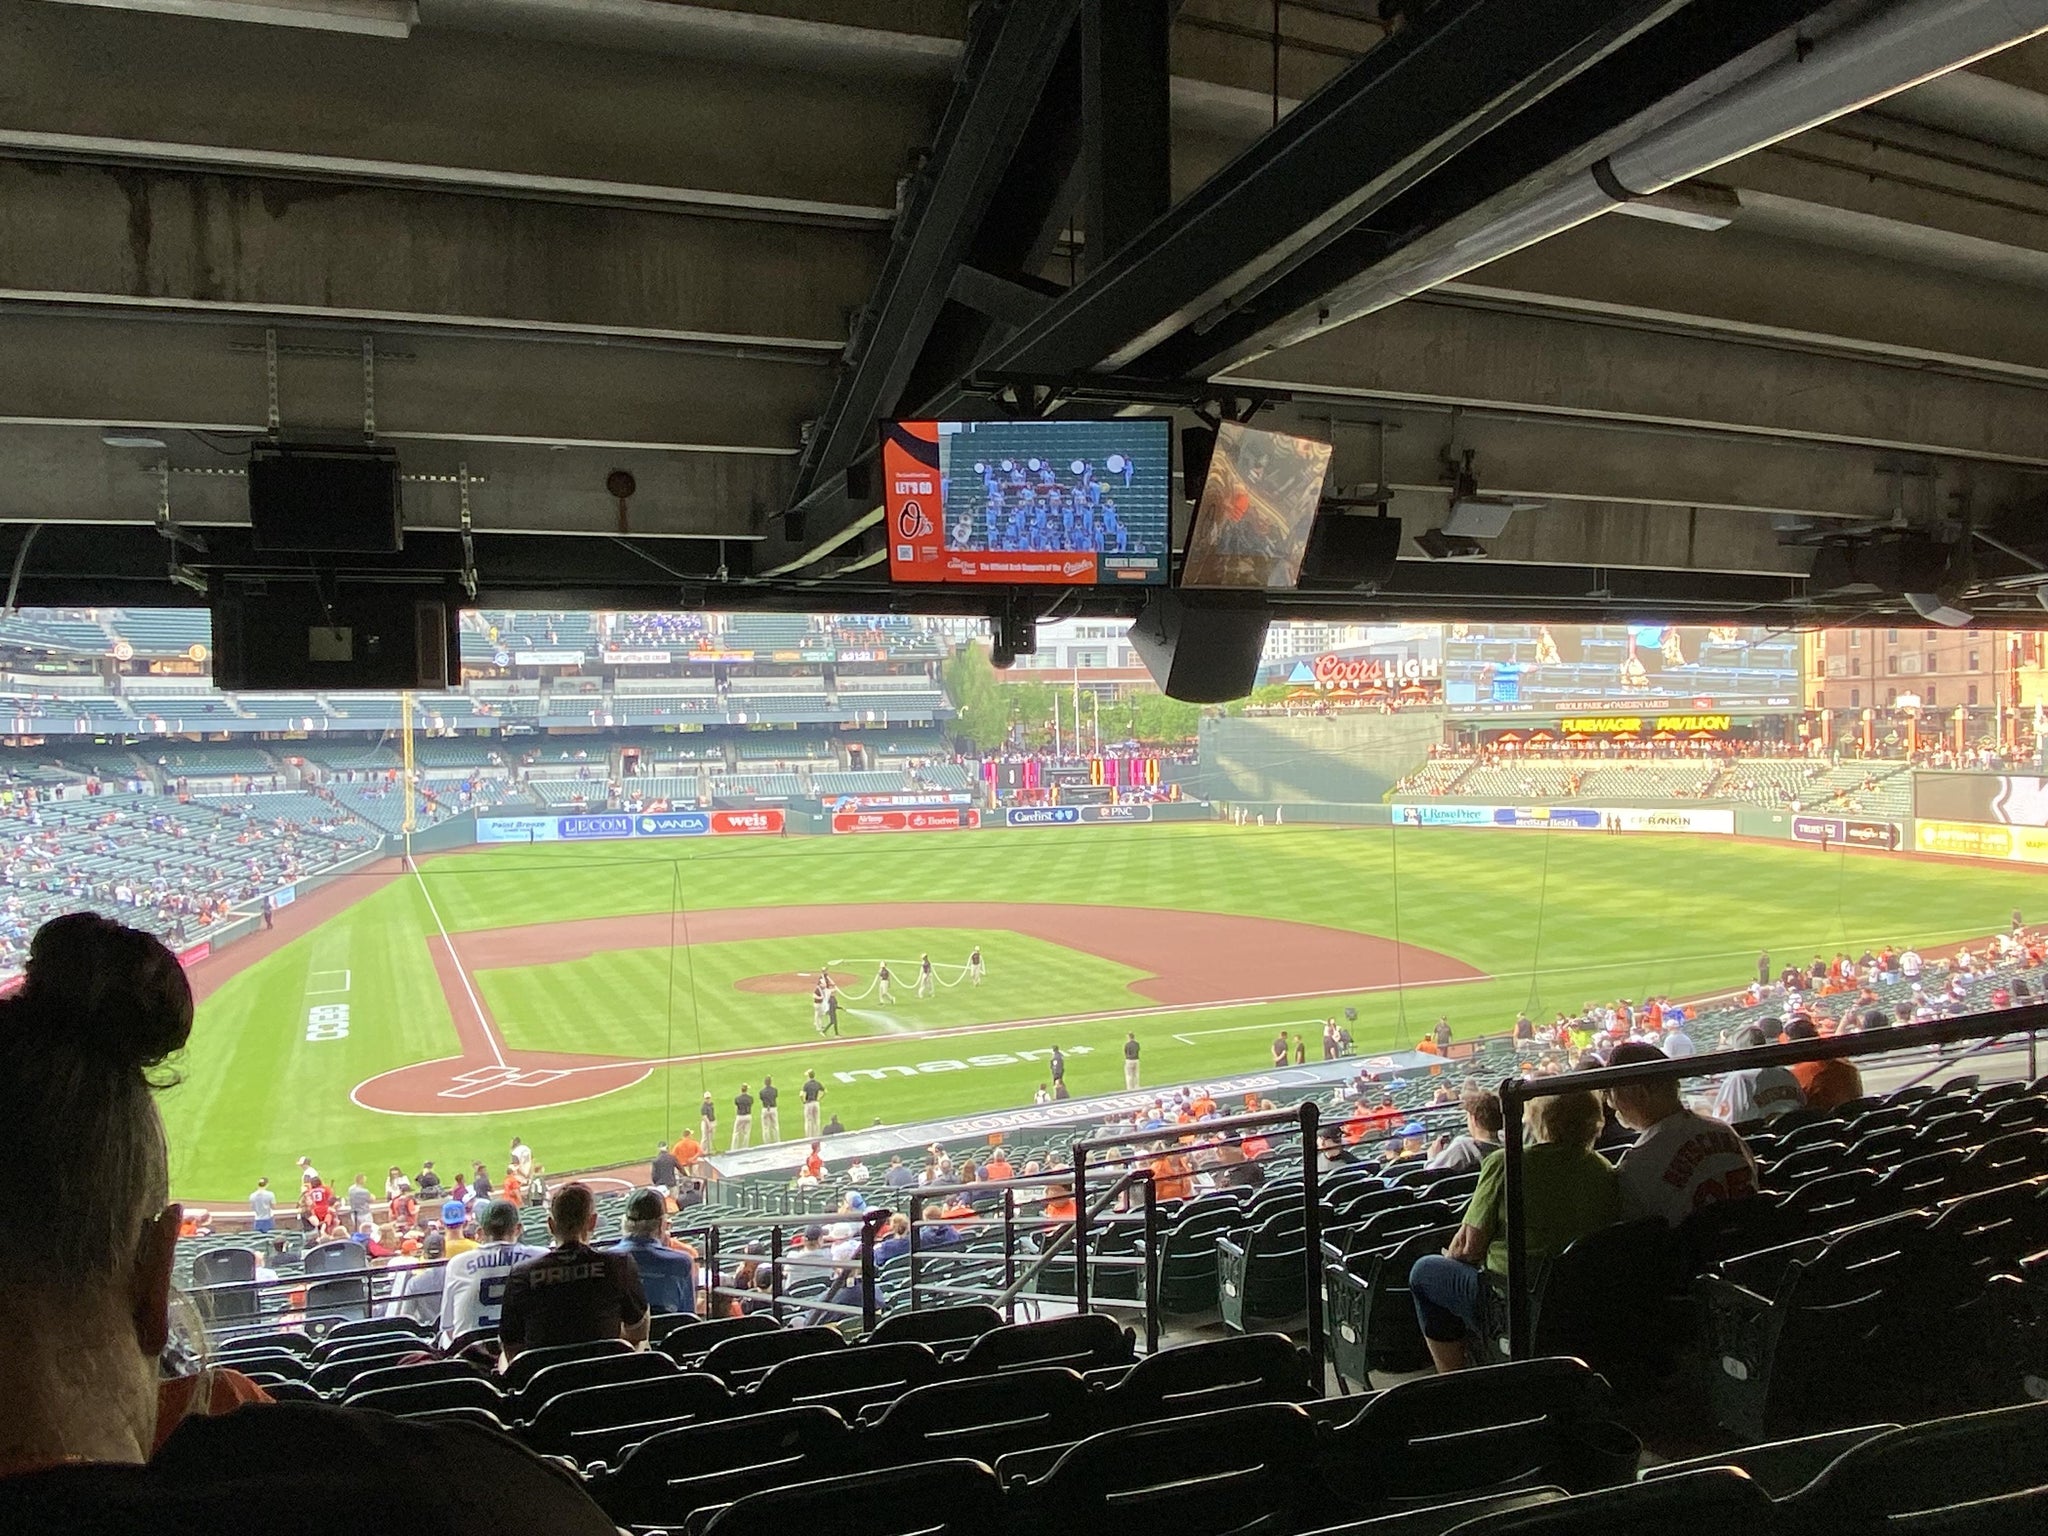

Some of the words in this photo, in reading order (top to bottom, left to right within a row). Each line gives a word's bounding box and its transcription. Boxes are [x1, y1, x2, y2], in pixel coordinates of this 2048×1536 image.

[1315, 654, 1382, 681] Coors
[1384, 658, 1443, 679] LIGH
[1555, 702, 1583, 710] ORIOLE
[1583, 702, 1603, 710] PARK
[1610, 700, 1643, 709] CAMDEN
[1644, 699, 1669, 708] YARDS
[1655, 716, 1730, 731] PAVILION
[1014, 810, 1054, 823] CareFirst
[1110, 807, 1133, 816] PNC
[1457, 808, 1481, 819] Price
[565, 819, 627, 832] LECOM
[657, 819, 704, 829] VANDA
[727, 812, 768, 828] weis
[1551, 819, 1578, 827] Health
[944, 1110, 1045, 1137] HOME
[1045, 1101, 1091, 1124] OF
[1089, 1088, 1155, 1115] THE
[529, 1260, 606, 1289] PRIDE
